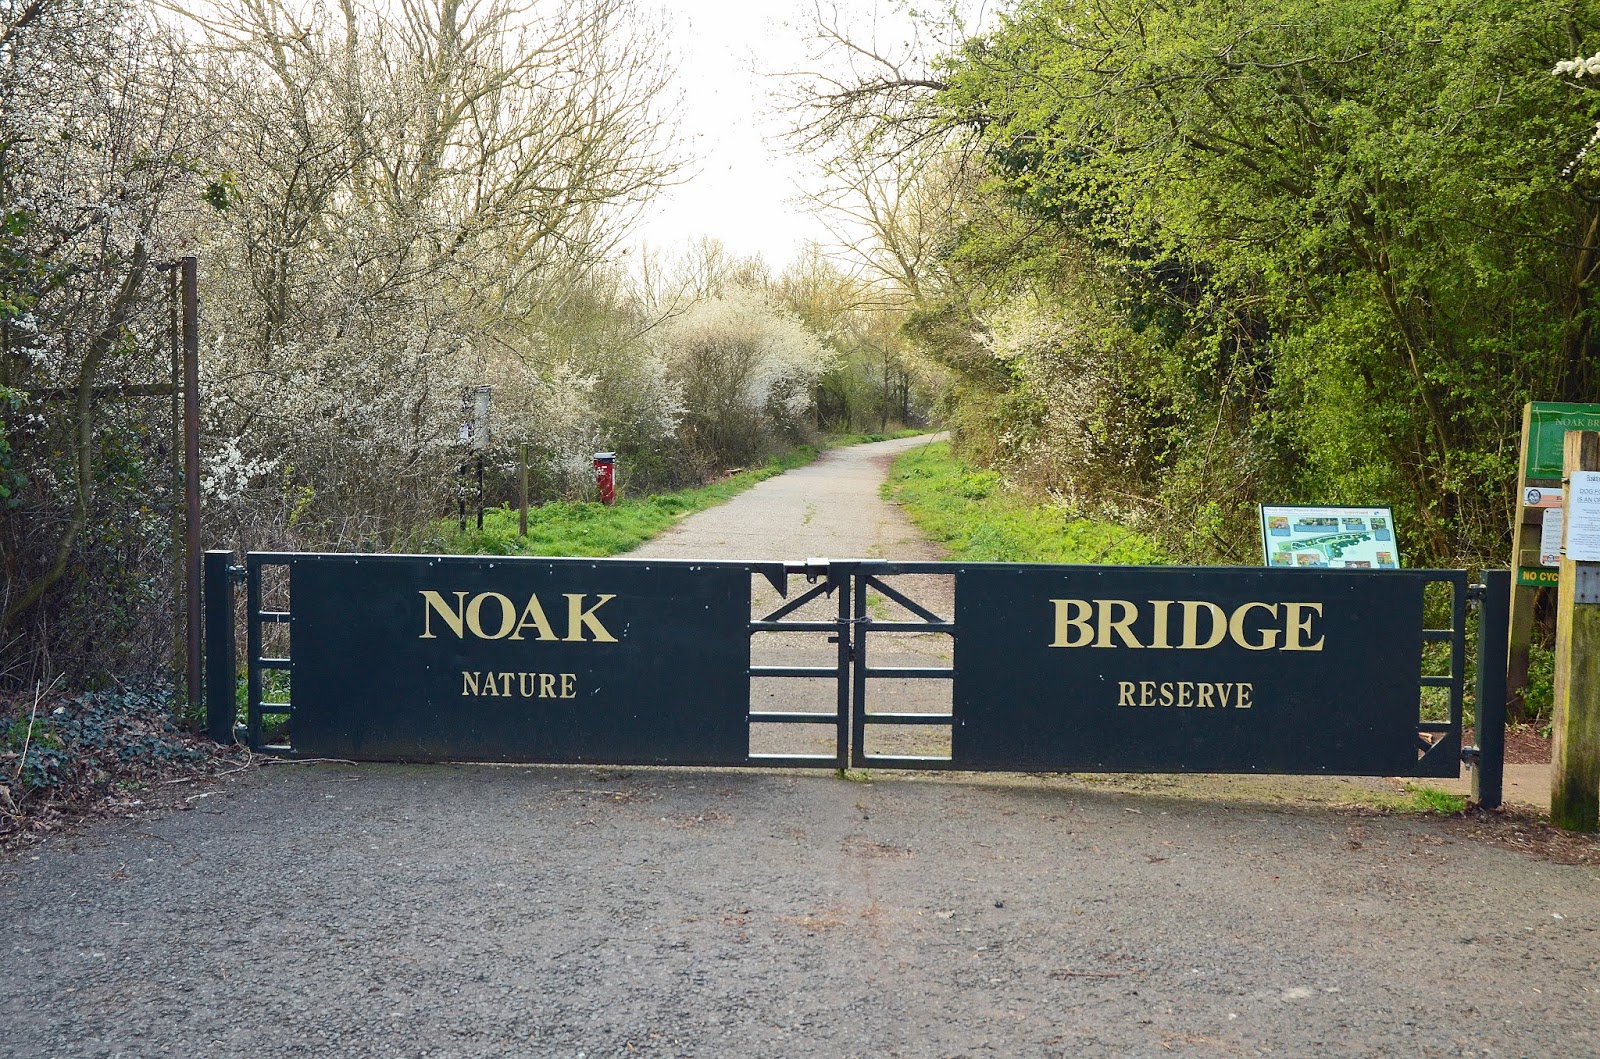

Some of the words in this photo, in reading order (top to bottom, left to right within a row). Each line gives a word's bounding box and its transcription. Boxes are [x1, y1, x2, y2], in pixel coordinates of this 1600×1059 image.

[1555, 418, 1585, 427] NOAK
[1523, 571, 1537, 581] NO
[418, 590, 619, 642] NOAK
[1047, 599, 1325, 651] BRIDGE
[461, 671, 577, 699] NATURE
[1117, 681, 1254, 709] RESERVE
